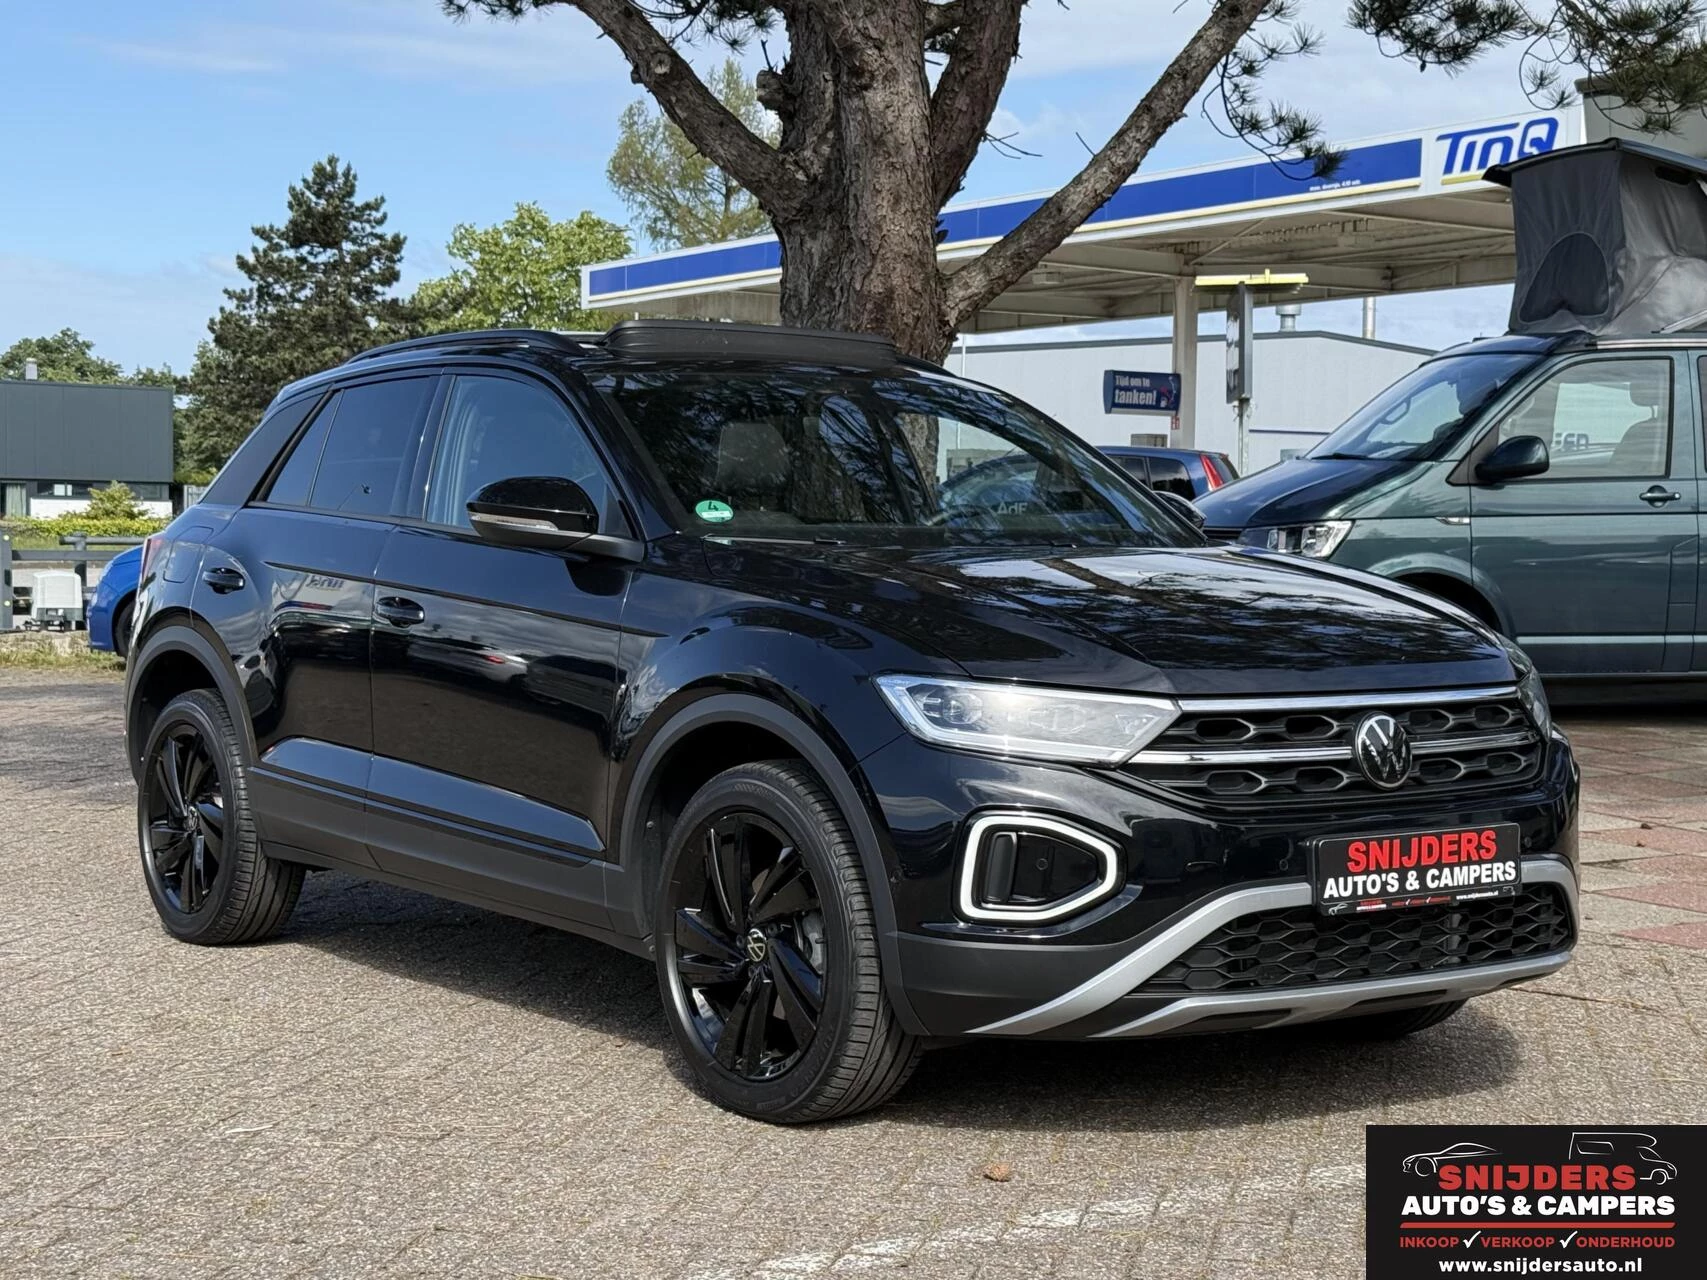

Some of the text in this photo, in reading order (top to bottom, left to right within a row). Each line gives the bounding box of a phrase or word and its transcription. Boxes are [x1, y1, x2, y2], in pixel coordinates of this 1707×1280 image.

[1436, 117, 1559, 175] TinQ
[1115, 376, 1150, 386] Tijd om te
[1114, 389, 1157, 406] tanken!
[708, 501, 719, 511] 4
[1347, 830, 1497, 873] SNIJDERS
[1324, 860, 1516, 899] AUTO'S & CAMPERS
